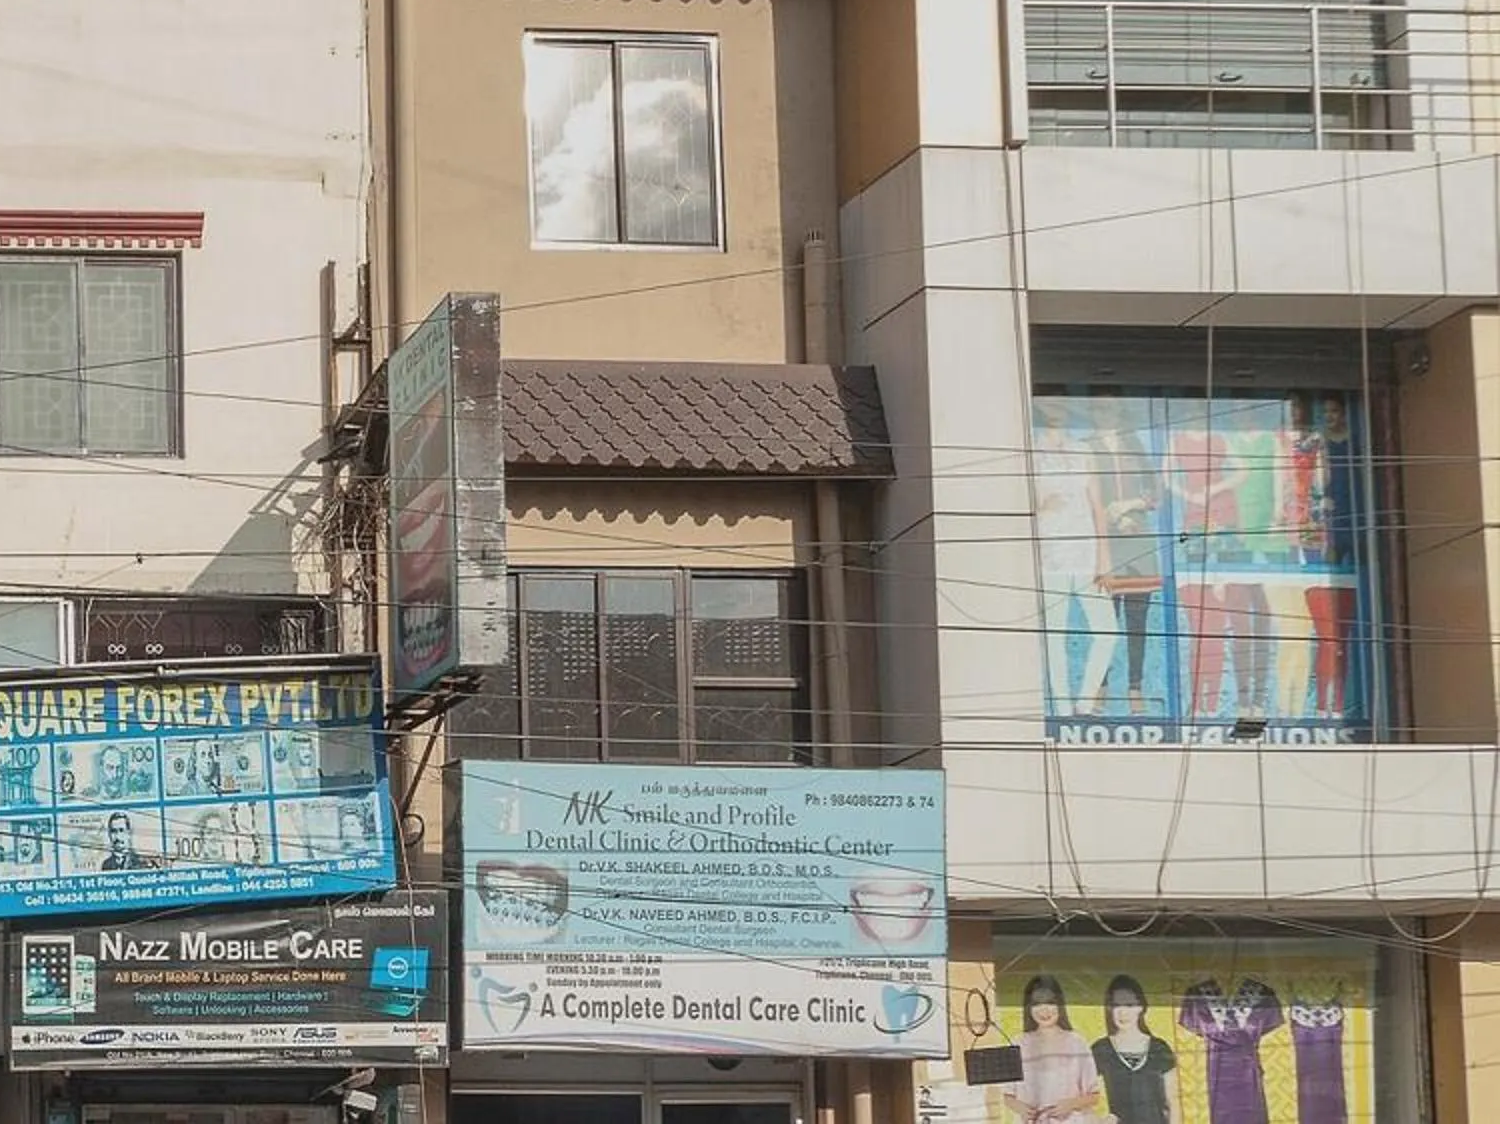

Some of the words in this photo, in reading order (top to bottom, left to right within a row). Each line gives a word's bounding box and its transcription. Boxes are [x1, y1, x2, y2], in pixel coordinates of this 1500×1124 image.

[116, 682, 232, 732] FOREX
[1182, 725, 1355, 744] FAIONS
[563, 790, 613, 825] NK
[623, 803, 680, 825] Smile
[686, 804, 722, 825] and
[729, 805, 798, 826] Profile
[919, 796, 935, 808] 74
[526, 829, 594, 851] Dental
[600, 829, 660, 852] Clinic
[668, 830, 687, 852] &
[689, 831, 820, 854] Orthodontic
[824, 835, 894, 855] Center
[625, 861, 690, 874] SHAKEEL
[629, 909, 685, 921] NAVEED
[131, 971, 163, 983] Brand
[165, 971, 200, 983] Mobile
[202, 971, 211, 983] &
[213, 971, 249, 985] Laptop
[251, 971, 290, 983] Service
[291, 970, 320, 982] Done
[321, 970, 346, 982] Here
[540, 993, 556, 1018] A
[562, 993, 666, 1024] Complete
[672, 995, 742, 1021] Dental
[749, 996, 801, 1022] Care
[806, 996, 867, 1023] Clinic
[34, 1031, 75, 1045] iPhone
[131, 1029, 181, 1043] NOKIA
[250, 1027, 287, 1037] SONY
